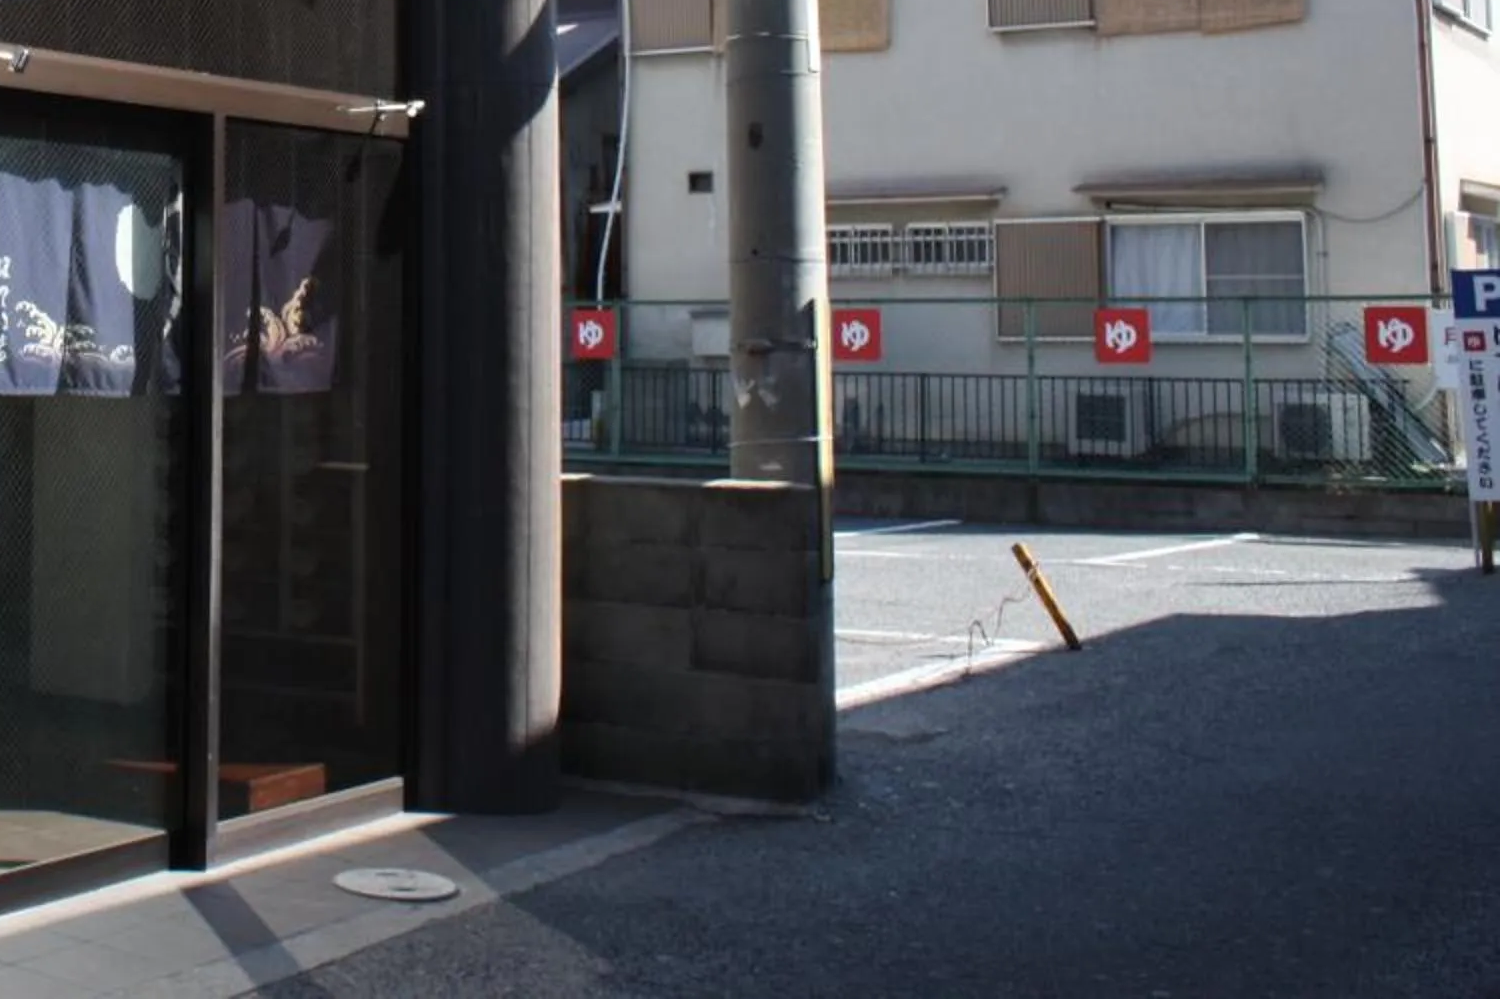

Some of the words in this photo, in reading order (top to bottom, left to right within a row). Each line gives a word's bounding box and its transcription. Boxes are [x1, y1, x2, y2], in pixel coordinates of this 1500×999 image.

[1473, 276, 1500, 312] P
[579, 320, 604, 348] ゆ
[841, 319, 870, 351] ゆ
[1105, 319, 1137, 353] ゆ
[1378, 317, 1414, 352] ゆ
